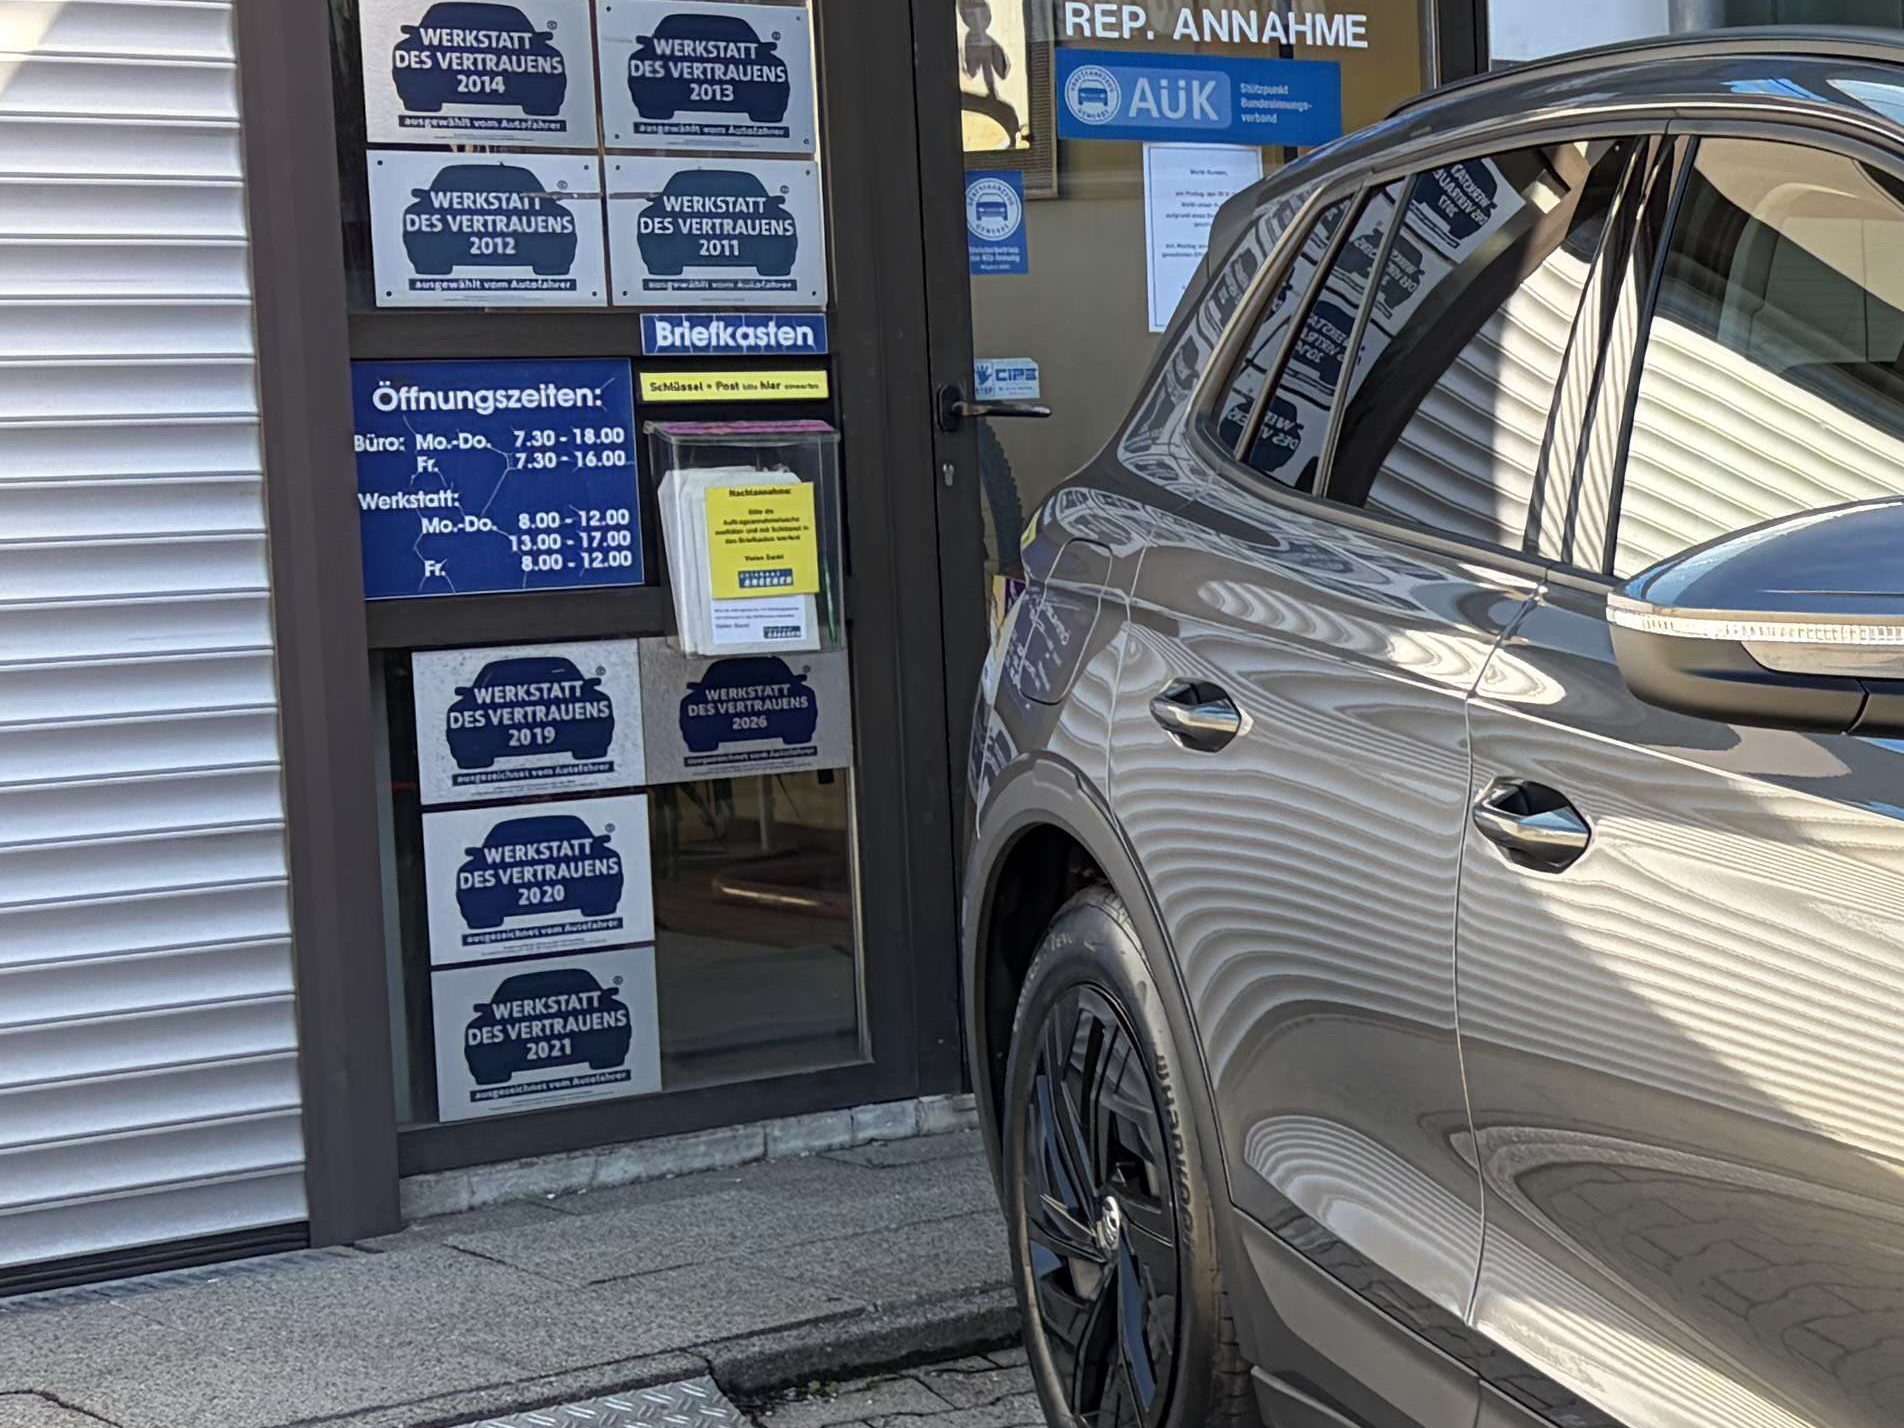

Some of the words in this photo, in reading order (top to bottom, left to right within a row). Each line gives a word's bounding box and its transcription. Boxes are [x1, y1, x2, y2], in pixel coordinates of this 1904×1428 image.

[1064, 1, 1155, 40] REP.
[1173, 8, 1368, 48] ANNAHME
[419, 28, 532, 49] WERKSTATT
[653, 38, 758, 59] WERKSTATT
[395, 50, 432, 69] DES
[436, 52, 563, 74] VERTRAUENS
[630, 60, 665, 77] DES
[668, 63, 785, 82] VERTRAUENS
[457, 75, 505, 93] 2014
[690, 84, 734, 101] 2013
[663, 196, 767, 214] WERKSTATT
[406, 214, 442, 232] DES
[447, 215, 573, 233] VERTRAUENS
[640, 218, 674, 234] DES
[678, 218, 794, 236] VERTRAUENS
[470, 237, 516, 254] 2012
[699, 240, 740, 256] 2011
[655, 320, 814, 348] Briefkasten
[716, 382, 739, 391] Post
[372, 381, 601, 415] Öffnungszeiten:
[353, 434, 405, 452] Büro:
[416, 433, 491, 450] Mo.-Do.
[513, 429, 555, 447] 7.30
[573, 428, 624, 444] 18.00
[417, 456, 438, 472] Fr.
[516, 452, 558, 469] 7.30
[574, 450, 626, 467] 16.00
[358, 490, 459, 510] Werkstatt:
[422, 516, 497, 534] Mo.-Do.
[518, 512, 559, 529] 8.00
[579, 509, 629, 526] 12.00
[511, 534, 561, 552] 13.00
[580, 531, 630, 547] 17.00
[425, 561, 445, 577] Fr.
[521, 554, 562, 570] 8.00
[582, 550, 632, 568] 12.00
[474, 680, 583, 704] WERKSTATT
[706, 684, 791, 701] WERKSTATT
[450, 710, 485, 729] DES
[488, 701, 610, 726] VERTRAUENS
[688, 703, 716, 717] DES
[717, 697, 808, 714] VERTRAUENS
[732, 716, 767, 730] 2026
[509, 727, 556, 747] 2019
[484, 838, 593, 864] WERKSTATT
[460, 870, 496, 889] DES
[498, 858, 619, 885] VERTRAUENS
[518, 885, 565, 905] 2020
[492, 991, 602, 1020] WERKSTATT
[468, 1026, 504, 1046] DES
[507, 1010, 627, 1040] VERTRAUENS
[527, 1038, 572, 1060] 2021
